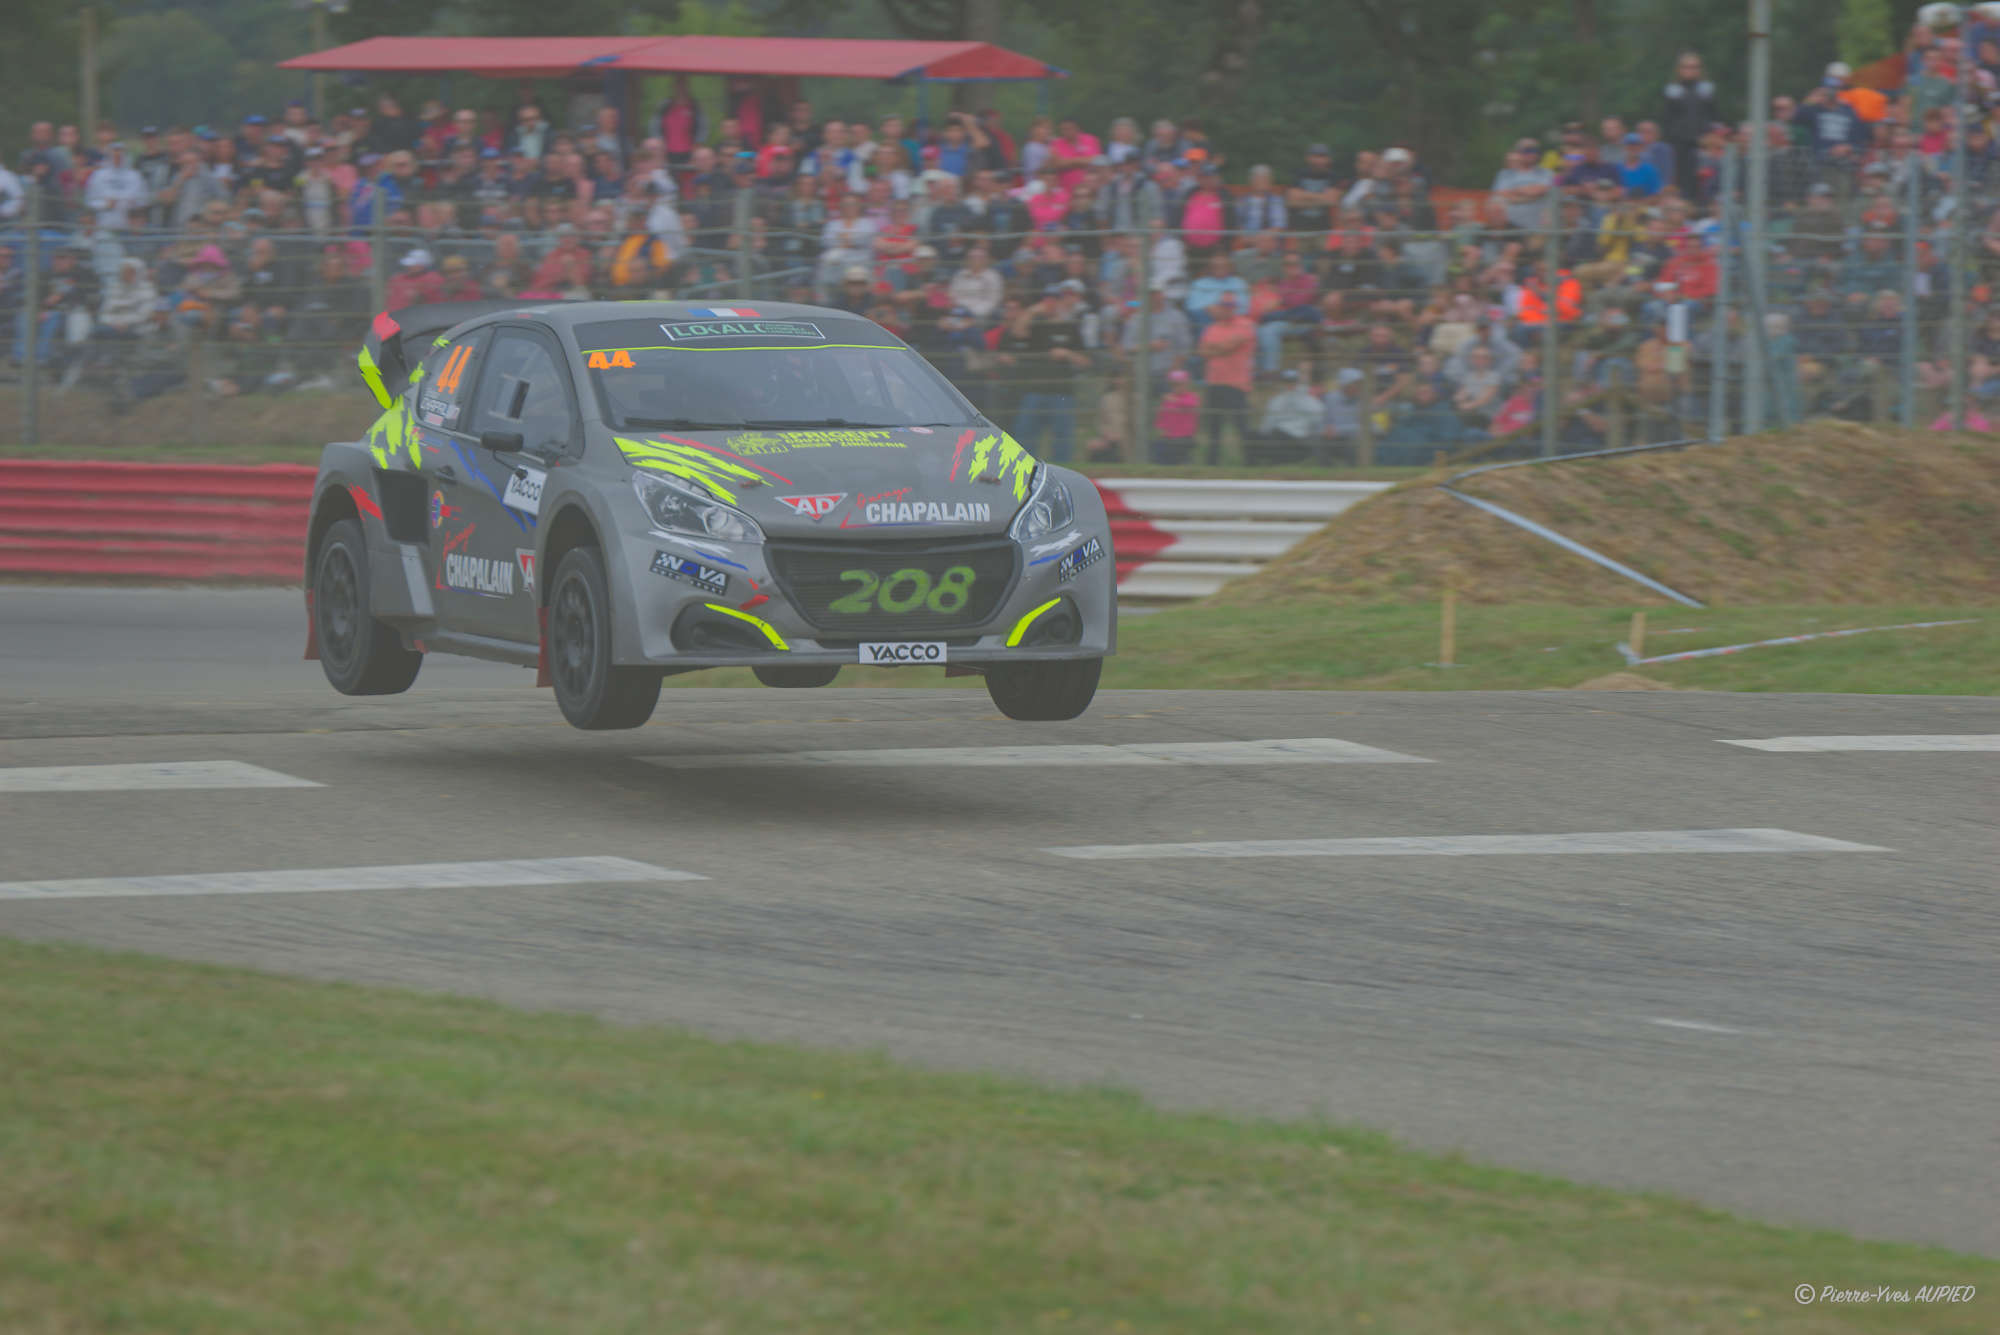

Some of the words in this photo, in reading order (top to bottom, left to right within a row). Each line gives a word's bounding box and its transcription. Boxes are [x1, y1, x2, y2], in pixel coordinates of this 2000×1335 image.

[436, 345, 473, 394] 44
[588, 350, 637, 370] 44
[796, 498, 835, 514] AD
[866, 502, 990, 522] CHAPALAIN
[446, 553, 513, 595] CHAPALAIN
[656, 553, 726, 586] NOVA
[828, 566, 976, 613] 208
[868, 644, 940, 661] YACCO
